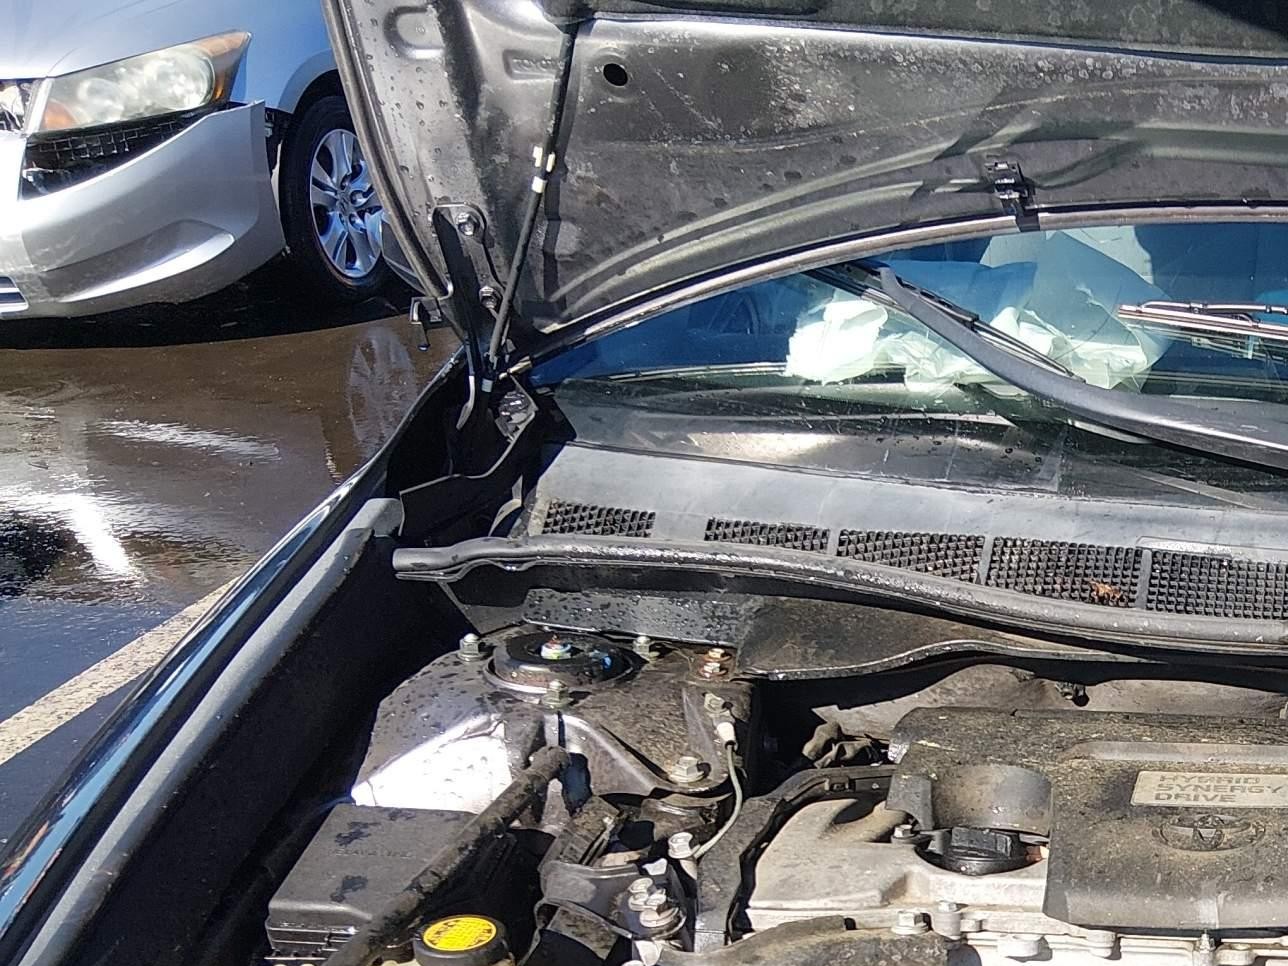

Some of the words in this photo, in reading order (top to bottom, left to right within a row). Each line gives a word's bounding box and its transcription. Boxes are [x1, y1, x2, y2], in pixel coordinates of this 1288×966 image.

[1159, 774, 1261, 785] HYBRID
[1156, 783, 1284, 794] SYNERGY
[1154, 792, 1237, 803] DRIVE
